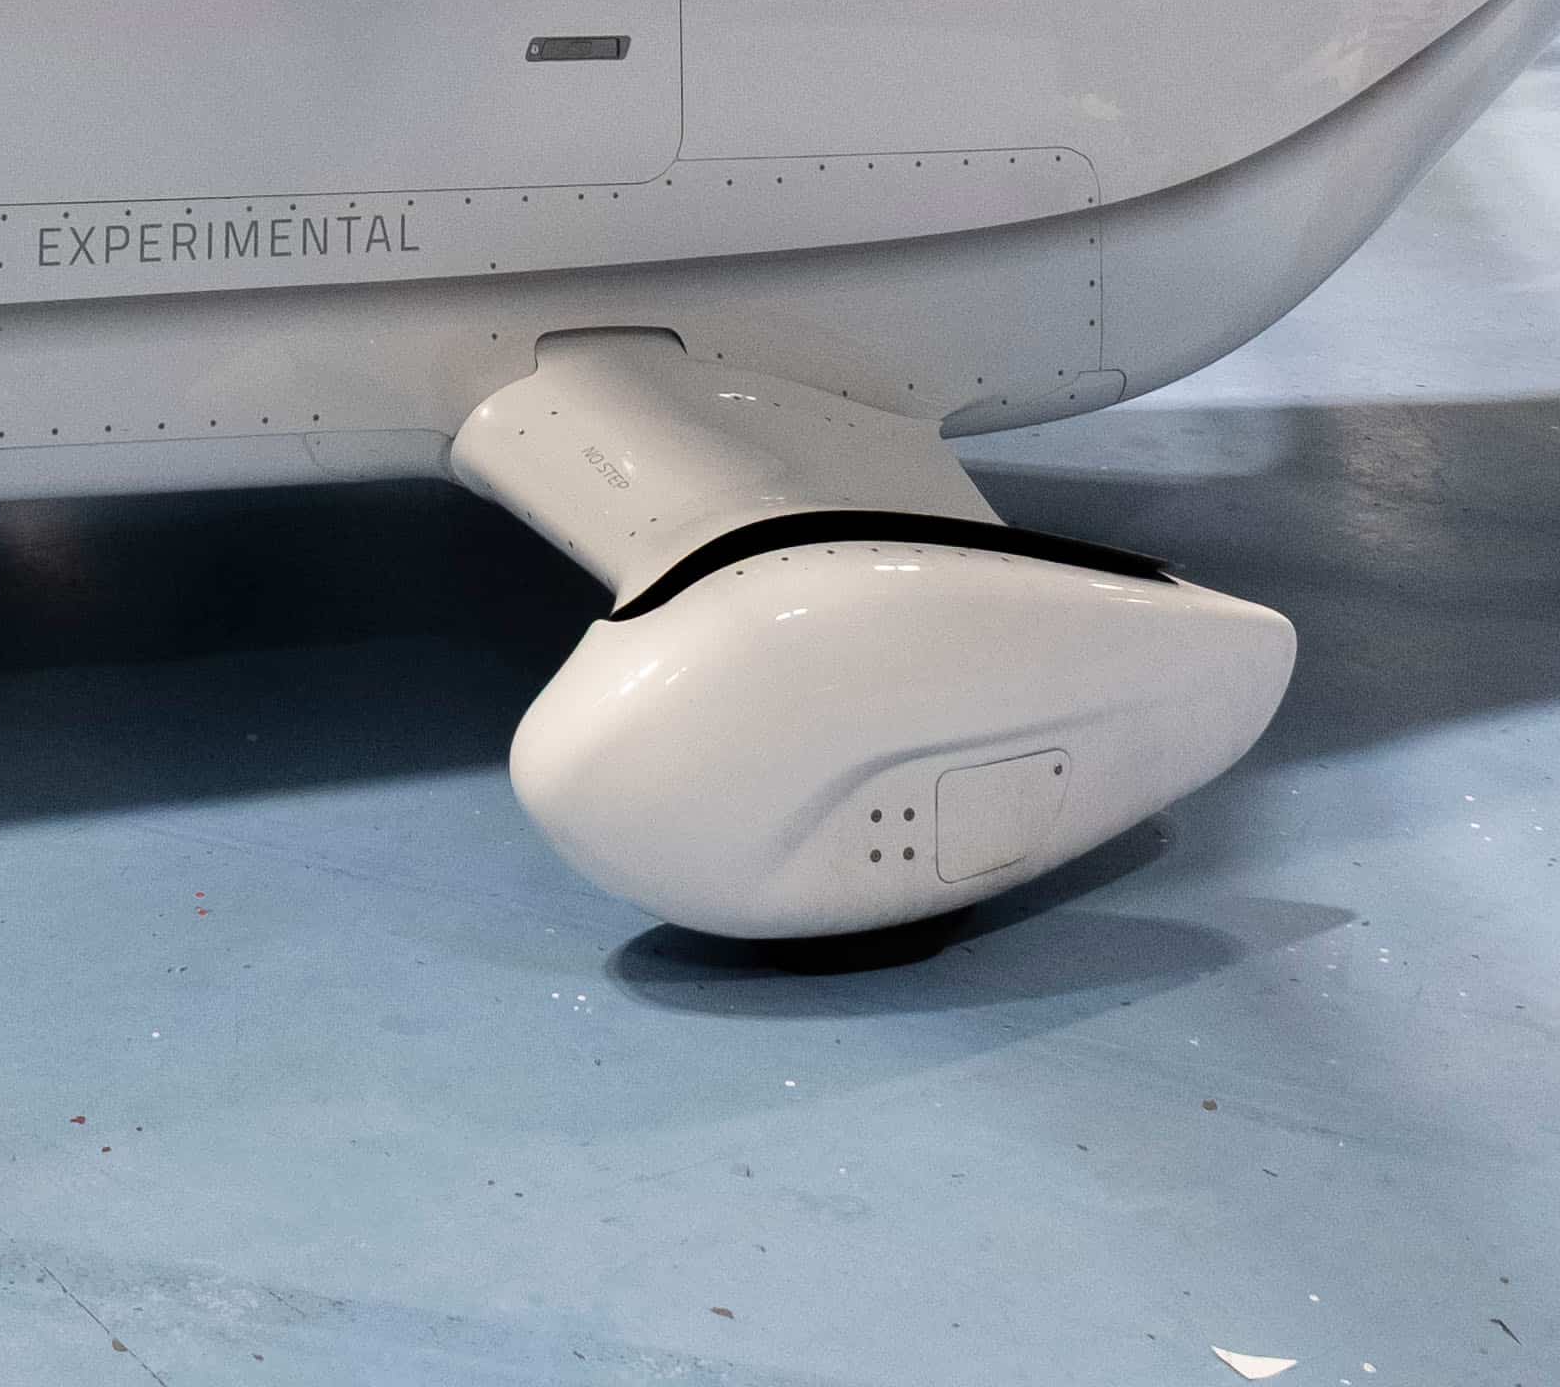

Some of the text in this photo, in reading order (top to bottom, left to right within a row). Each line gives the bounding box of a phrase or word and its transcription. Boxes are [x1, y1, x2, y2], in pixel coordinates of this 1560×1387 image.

[37, 214, 421, 268] EXPERIMENTAL
[581, 446, 629, 489] NO STEP
